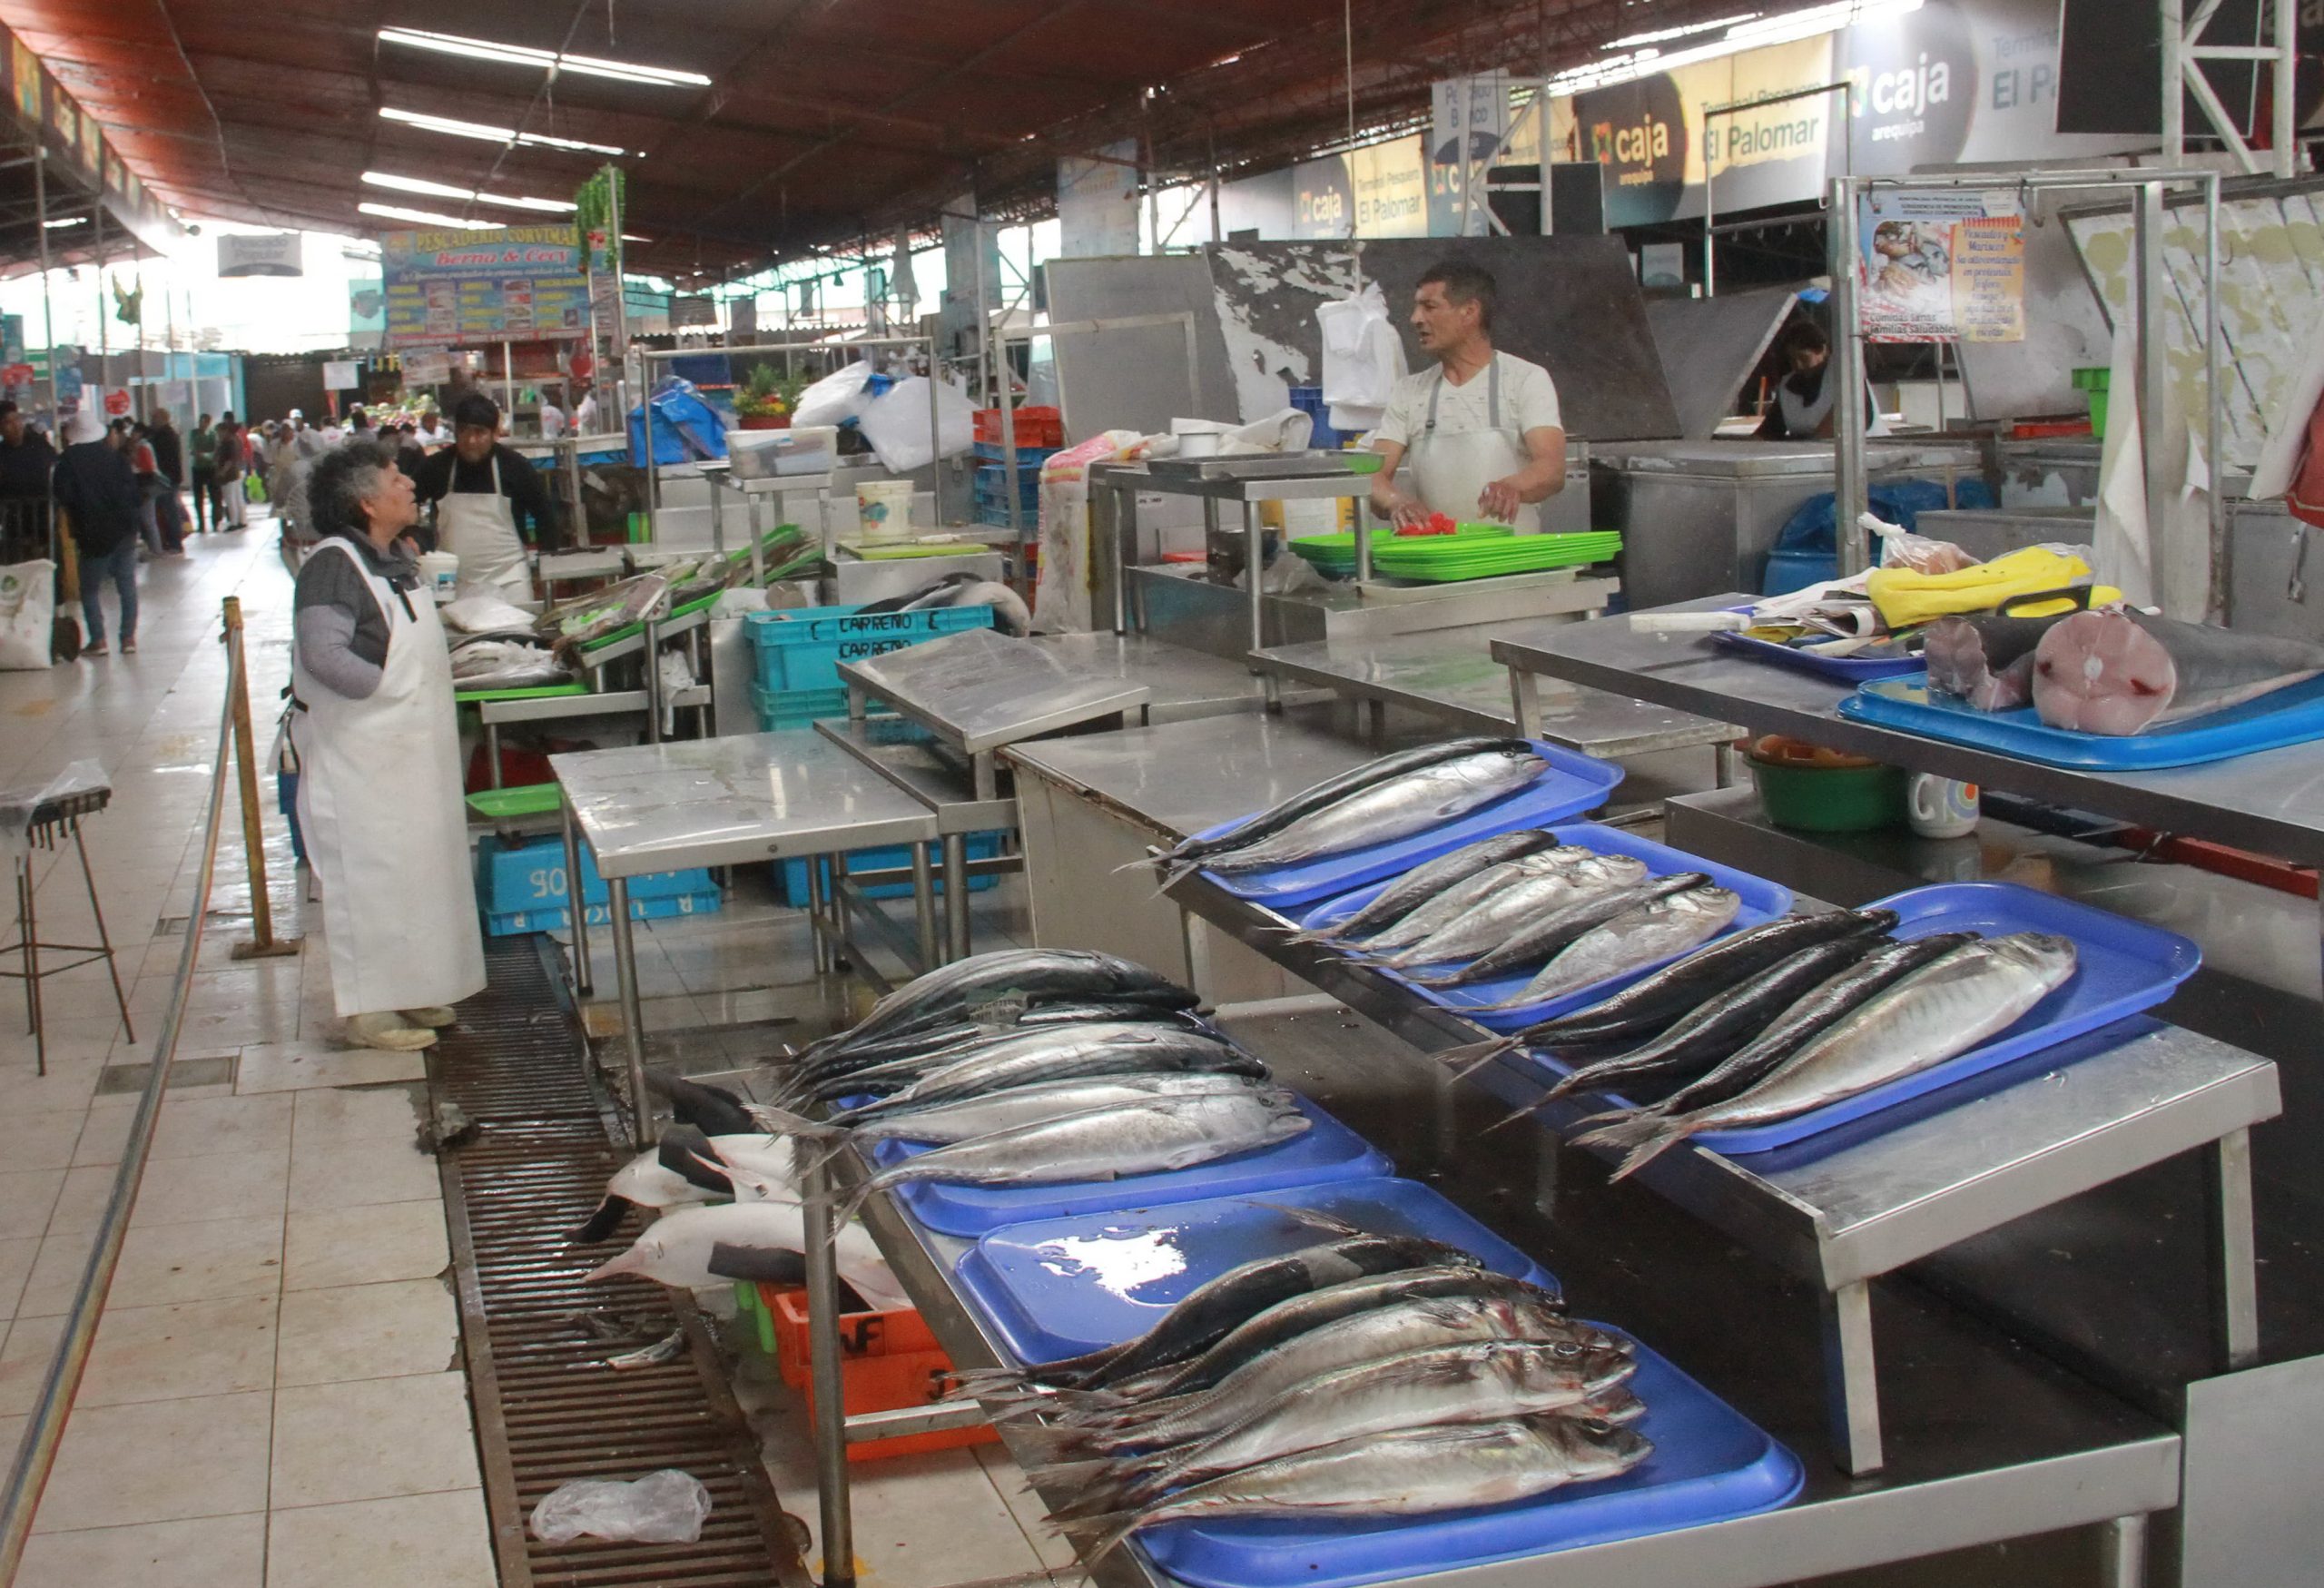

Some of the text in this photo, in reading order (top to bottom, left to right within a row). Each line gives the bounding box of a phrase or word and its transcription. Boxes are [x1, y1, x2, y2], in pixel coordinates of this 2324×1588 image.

[1872, 52, 1950, 116] caja
[1993, 64, 2056, 110] El P
[1615, 113, 1669, 168] caja
[1728, 116, 1820, 158] Palomar
[1872, 119, 1925, 142] arequipa
[1313, 185, 1343, 225] caja
[1374, 194, 1422, 221] Palomar
[1869, 324, 1958, 334] Familias Saludables
